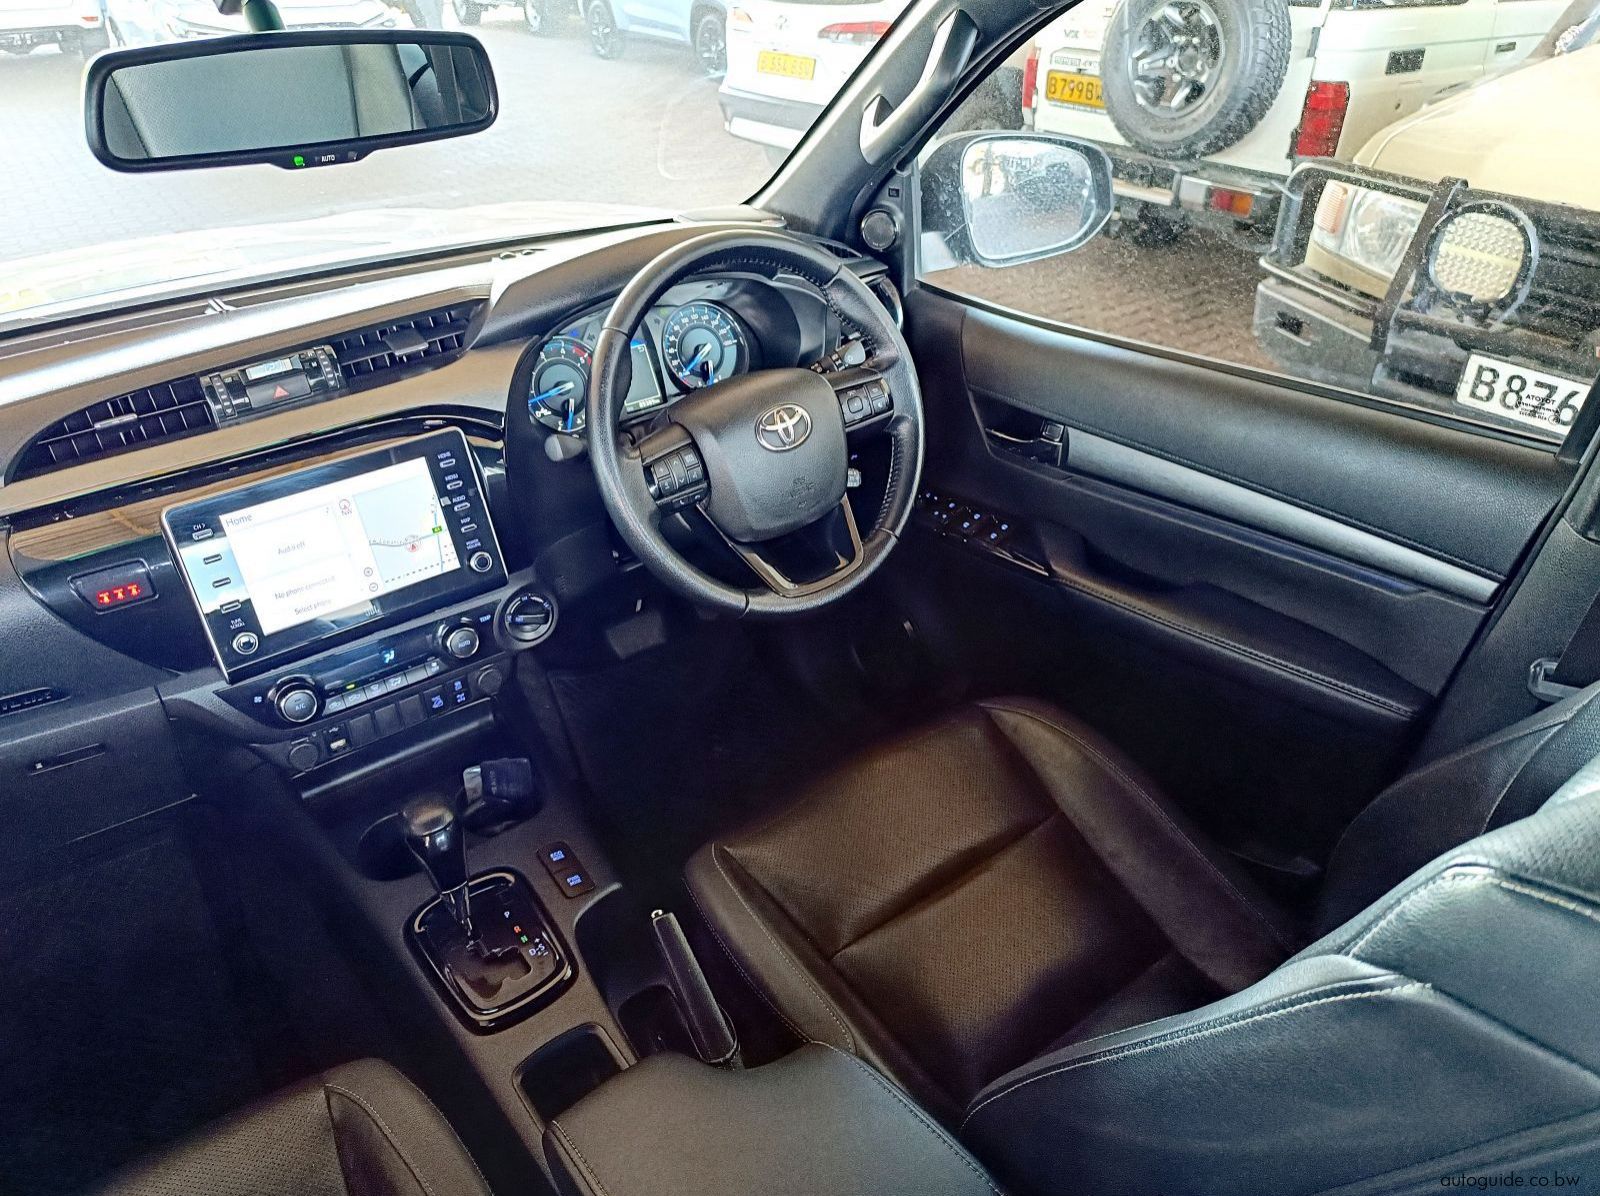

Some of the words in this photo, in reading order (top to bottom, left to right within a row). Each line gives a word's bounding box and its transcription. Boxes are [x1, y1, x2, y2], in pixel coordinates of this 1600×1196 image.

[321, 154, 336, 162] AUTO
[452, 495, 466, 503] AUDIO
[225, 514, 253, 527] Home
[480, 614, 491, 623] TEMP
[295, 702, 306, 712] A/C
[504, 911, 510, 919] P
[513, 925, 521, 934] R
